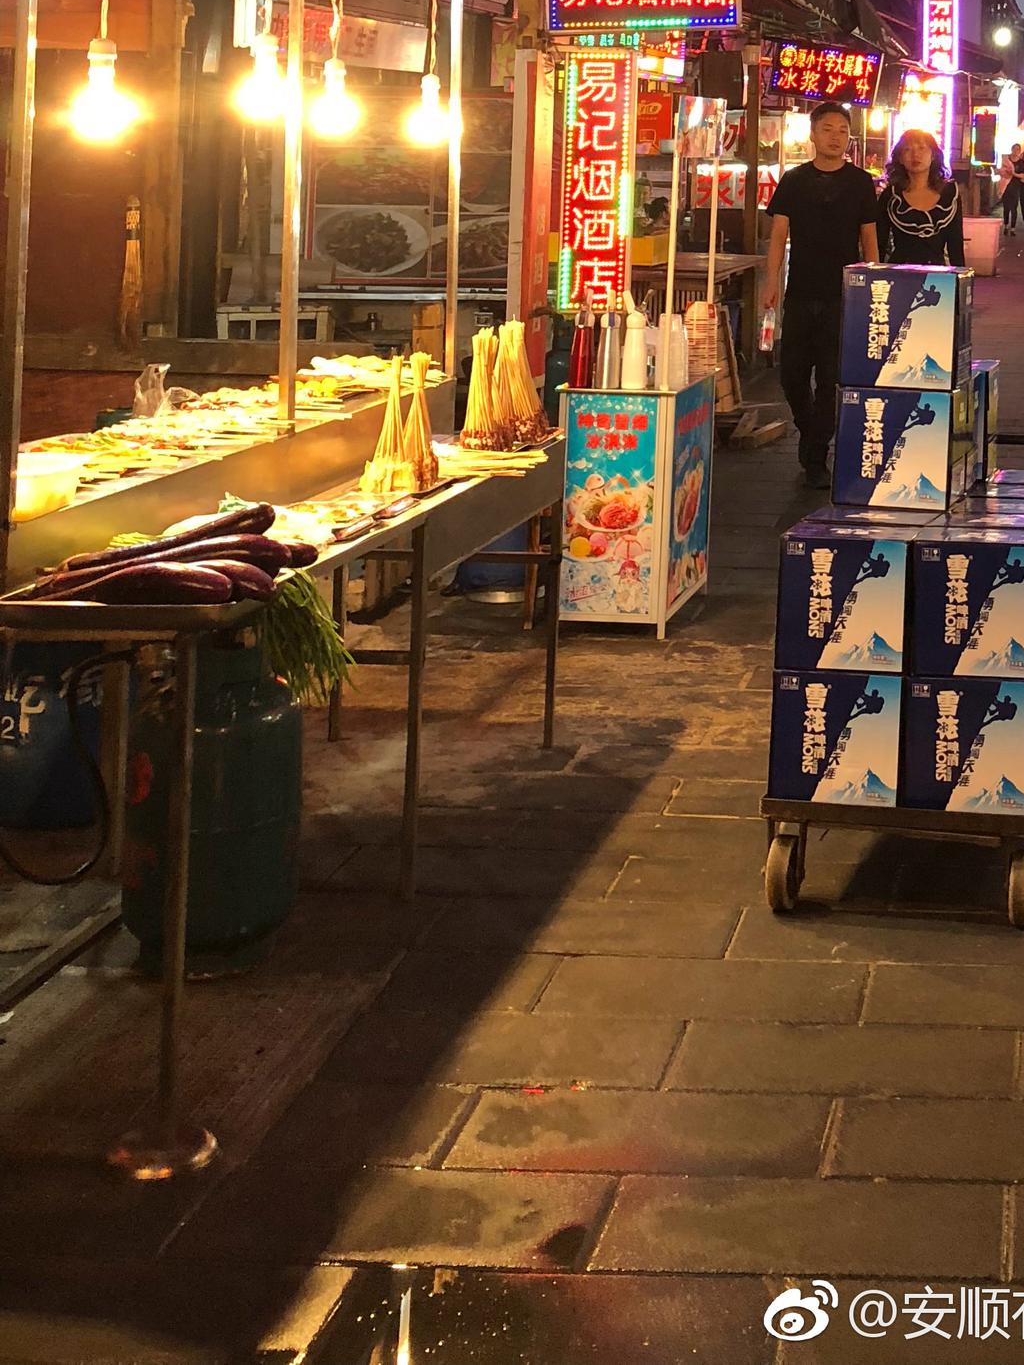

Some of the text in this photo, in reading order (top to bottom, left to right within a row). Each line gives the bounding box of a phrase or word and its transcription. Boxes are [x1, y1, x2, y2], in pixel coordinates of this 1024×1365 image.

[571, 60, 618, 302] 易记烟酒店
[868, 279, 891, 324] 雪花
[863, 397, 886, 442] 雪花
[809, 548, 834, 597] 雪花
[945, 553, 970, 604] 雪花
[803, 683, 829, 733] 雪花
[936, 690, 960, 740] 雪花
